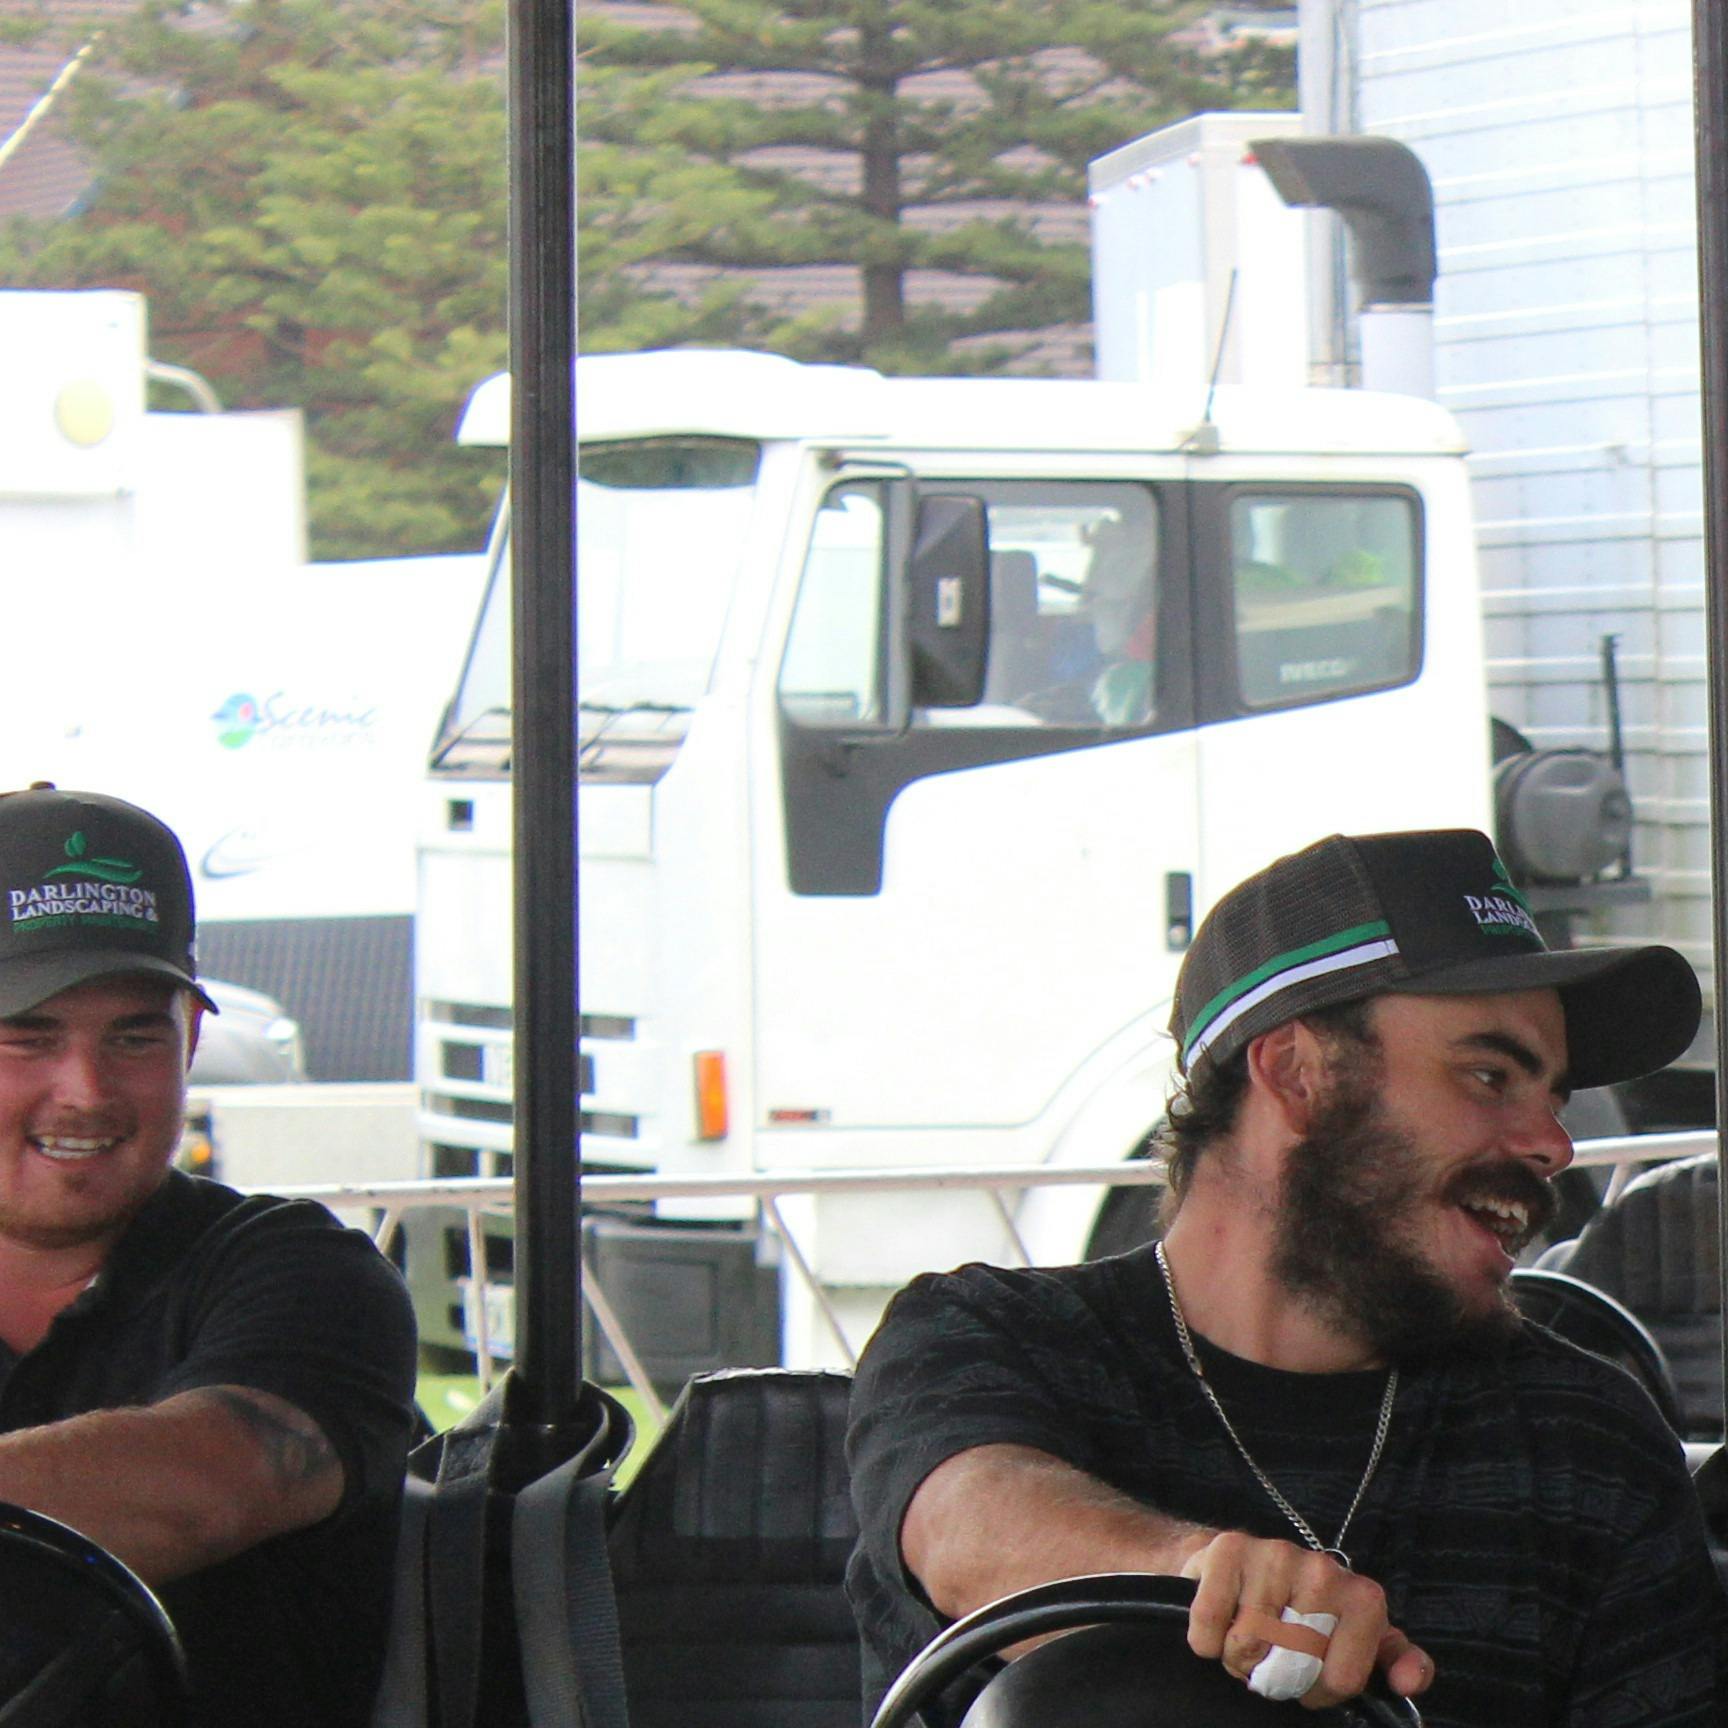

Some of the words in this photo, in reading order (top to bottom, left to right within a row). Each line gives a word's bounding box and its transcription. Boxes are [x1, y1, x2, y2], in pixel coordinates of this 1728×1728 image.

[257, 690, 376, 734] Scenic
[10, 882, 156, 907] DARLINGTON
[12, 899, 143, 921] LANDSCAPING
[145, 908, 159, 922] &
